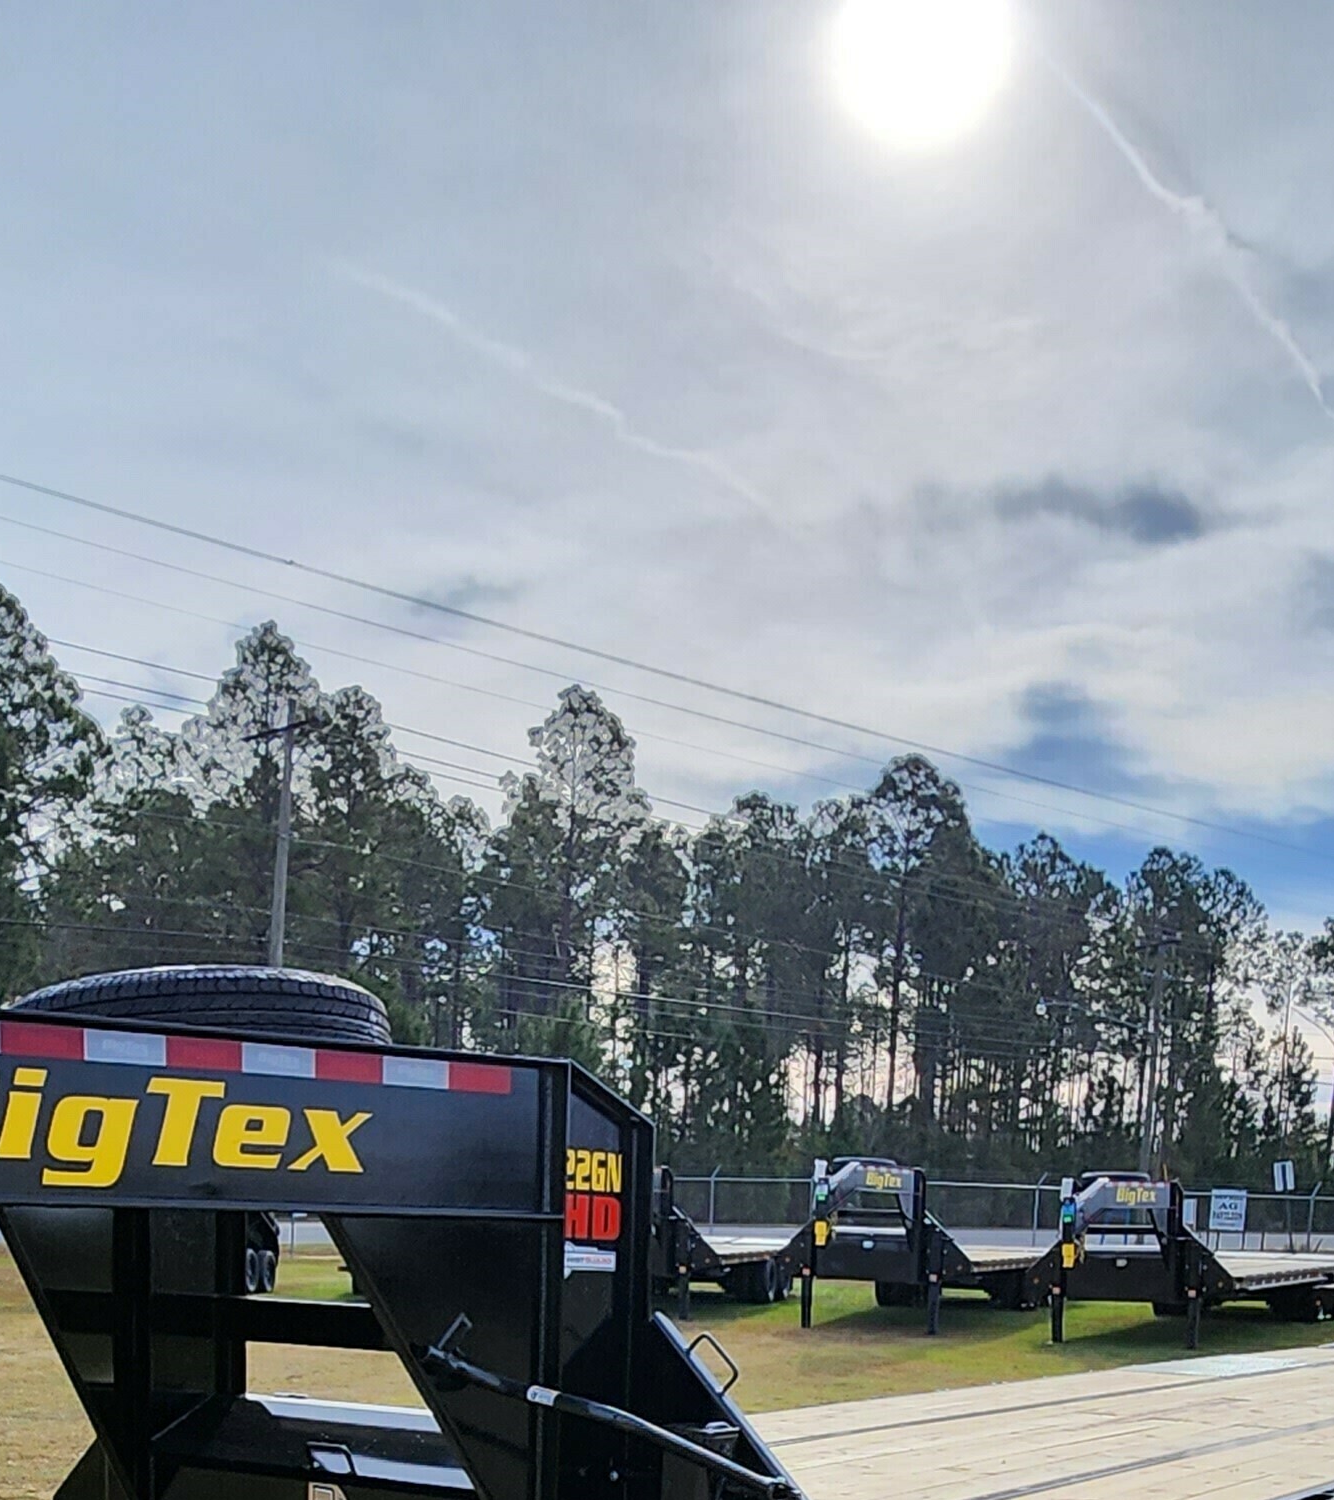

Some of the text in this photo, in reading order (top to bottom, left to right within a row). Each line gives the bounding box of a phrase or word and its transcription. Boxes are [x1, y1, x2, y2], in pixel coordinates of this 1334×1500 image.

[866, 1171, 902, 1190] BigTex
[1116, 1187, 1156, 1206] BigTex
[1217, 1201, 1239, 1211] AG
[565, 1193, 621, 1240] HD
